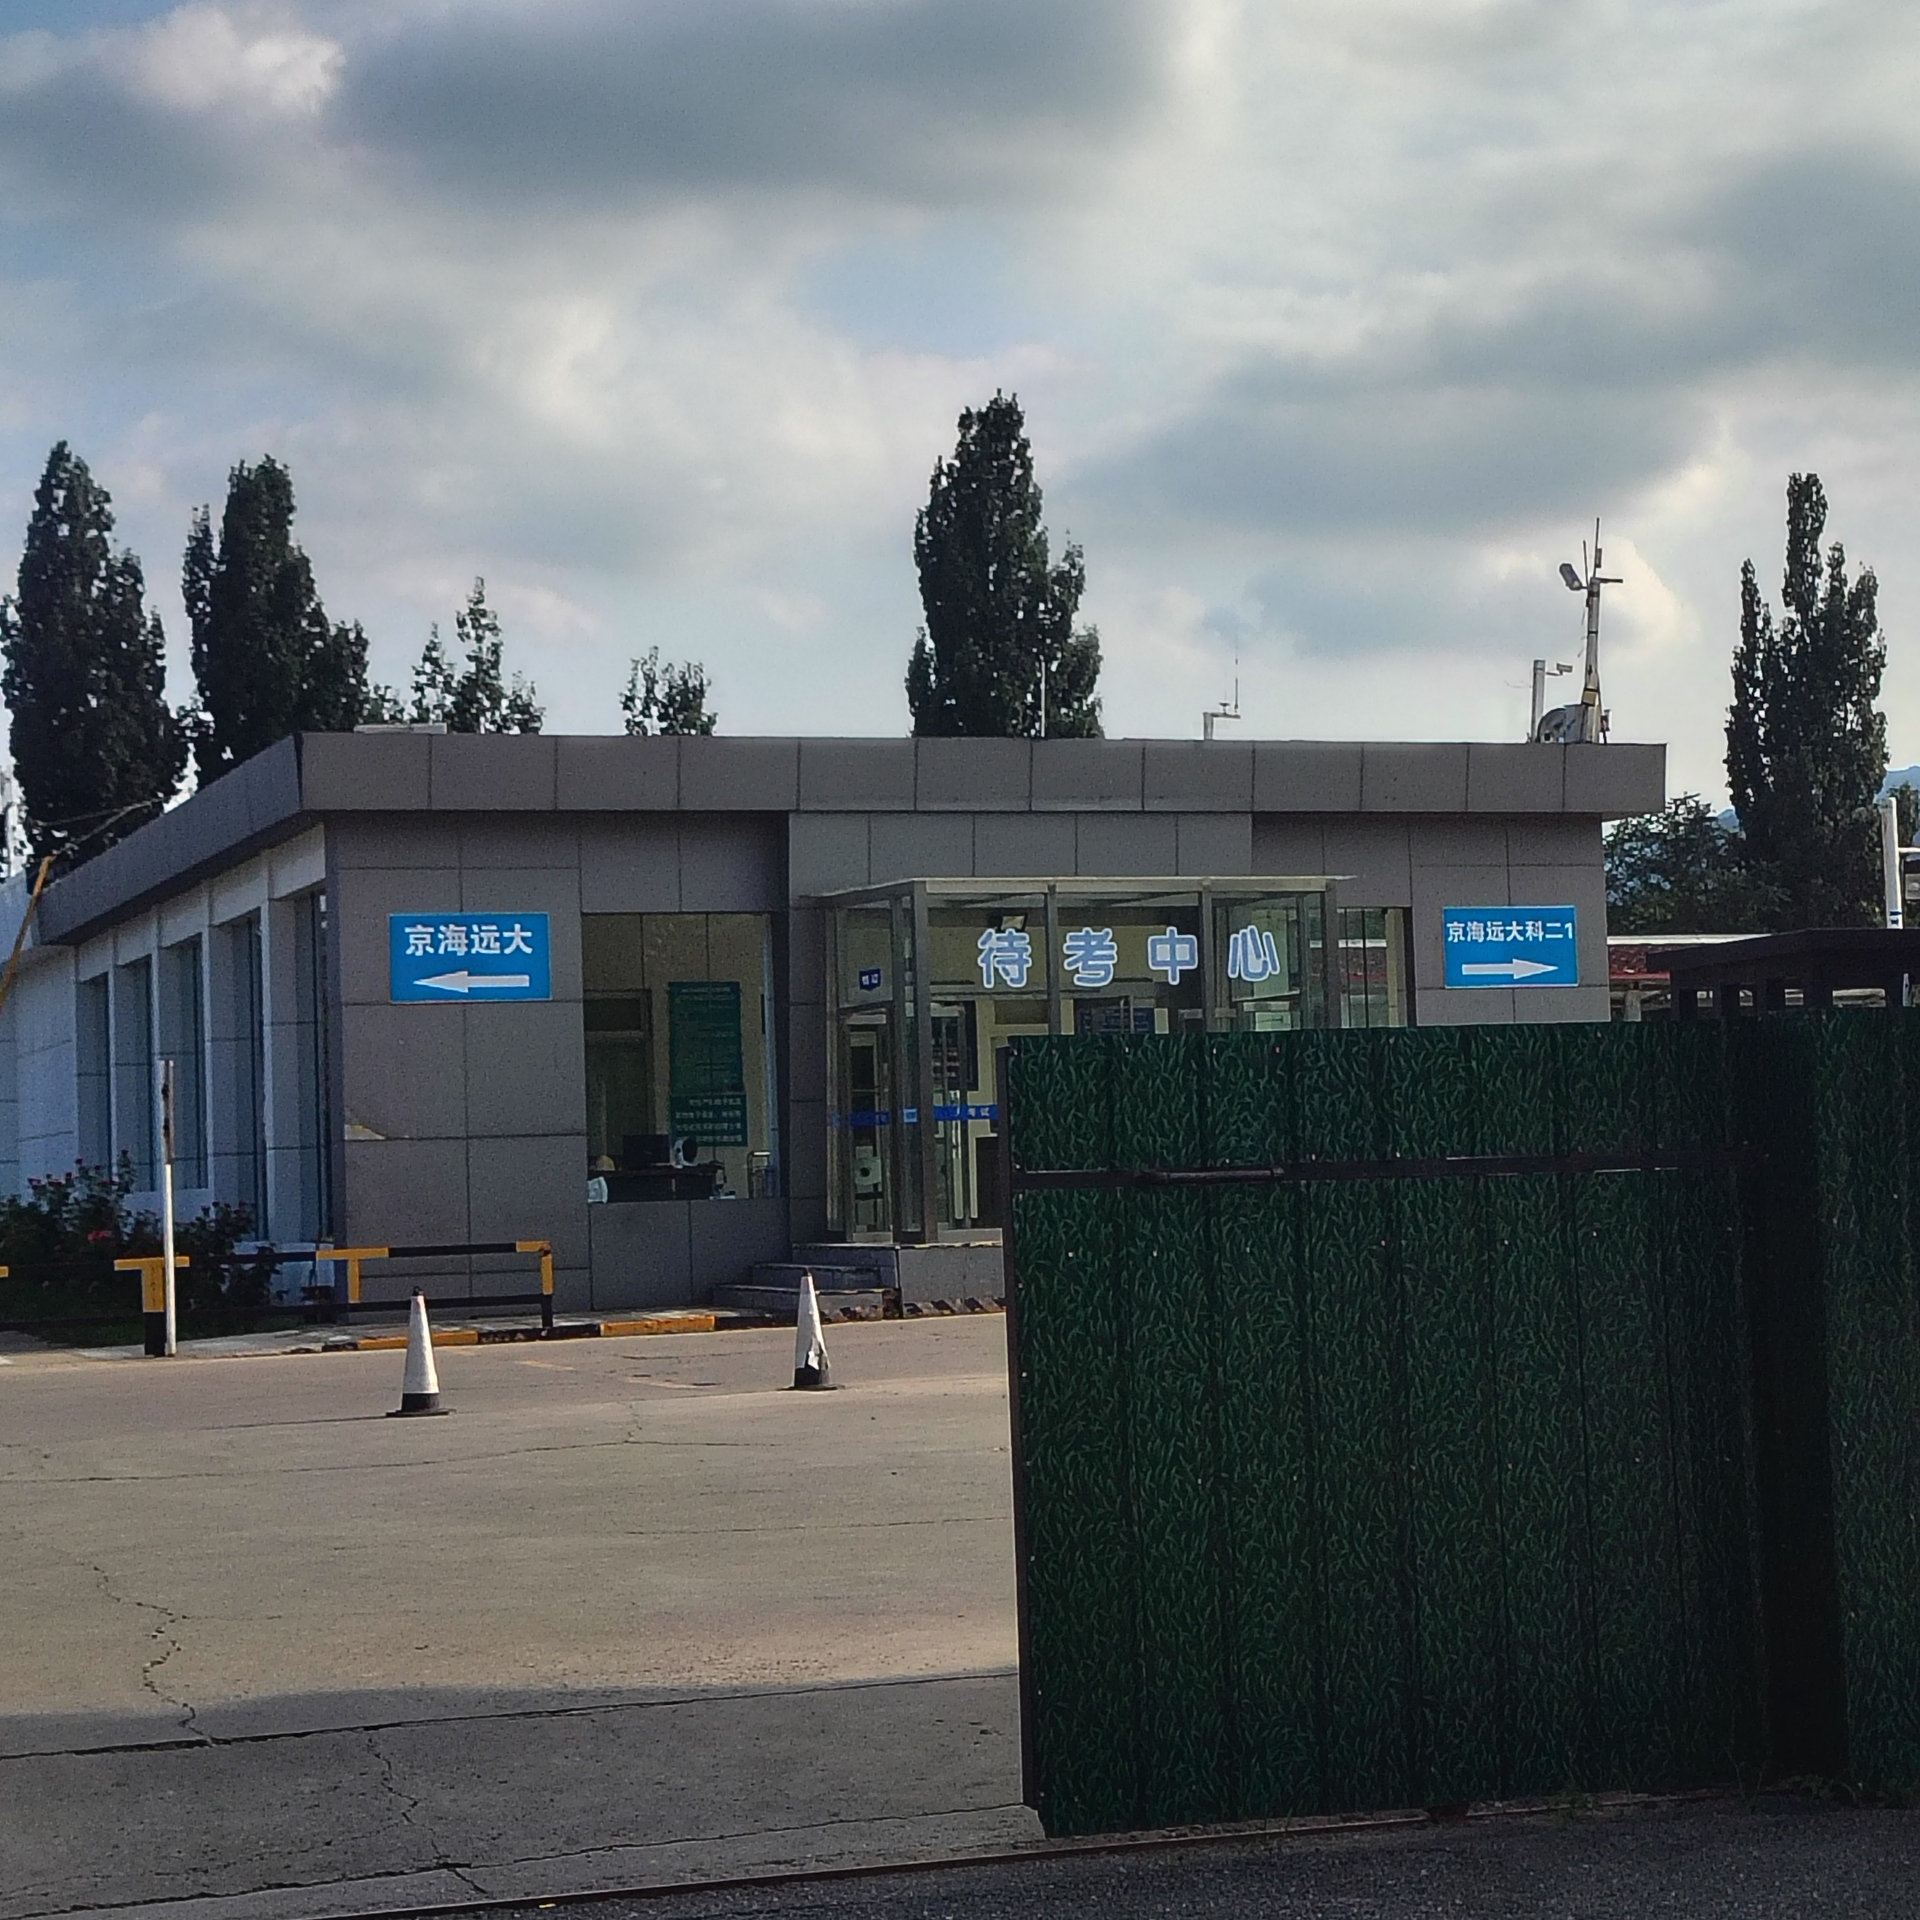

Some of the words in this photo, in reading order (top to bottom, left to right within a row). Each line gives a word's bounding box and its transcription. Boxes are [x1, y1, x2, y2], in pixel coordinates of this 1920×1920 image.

[404, 923, 533, 956] 京海远大
[1446, 920, 1573, 943] 京海远大科二1
[977, 925, 1280, 989] 待考中心
